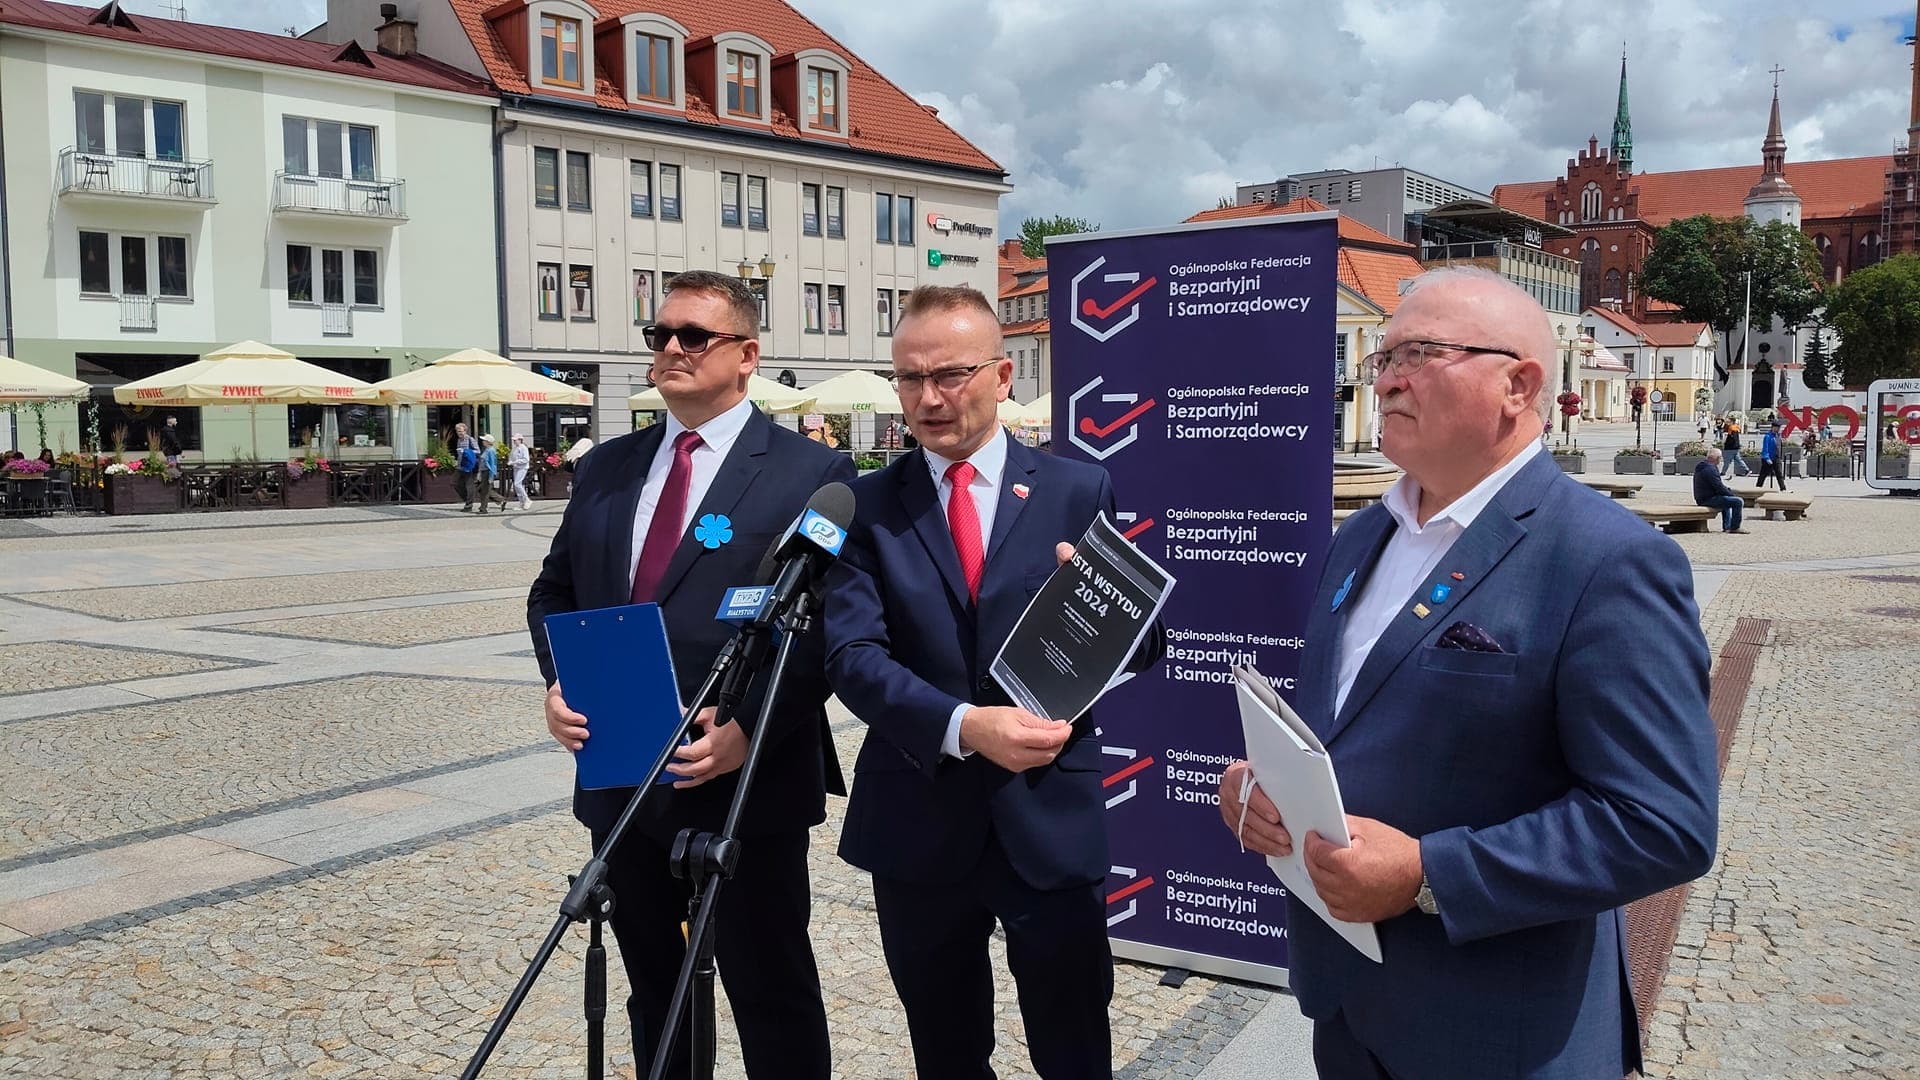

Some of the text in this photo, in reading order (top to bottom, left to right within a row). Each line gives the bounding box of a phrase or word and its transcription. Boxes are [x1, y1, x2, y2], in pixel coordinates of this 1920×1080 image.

[1169, 255, 1312, 276] Ogólnopolska Federacja
[1169, 275, 1261, 297] Bezpartyjni
[1168, 296, 1311, 316] i Samorządowcy
[136, 387, 164, 398] ŻYWIEC
[222, 385, 264, 396] ŻYWIEC
[325, 386, 355, 397] ŻYWIEC
[424, 389, 458, 399] ŻYWIEC
[516, 391, 547, 402] ŻYWIEC
[1167, 384, 1310, 399] Ogólnopolska Federacja
[1167, 402, 1259, 421] Bezpartyjni
[1167, 423, 1309, 441] i Samorządowcy
[1166, 508, 1308, 523] Ogólnopolska Federacja
[1166, 525, 1258, 544] Bezpartyjni
[1166, 545, 1308, 567] i Samorządowcy
[1071, 552, 1093, 579] ISTA
[1094, 573, 1142, 619] WSTYDU
[1074, 581, 1109, 618] 2024
[1166, 629, 1306, 649] Ogólnopolska Federacja
[1166, 645, 1257, 664] Bezpartyjni
[1165, 665, 1298, 690] i Samorzwc
[1166, 785, 1171, 799] i
[1166, 870, 1287, 896] Ogólnopolska Federa
[1166, 886, 1257, 914] Bezpartyjni
[1166, 906, 1288, 938] i Samorządow
